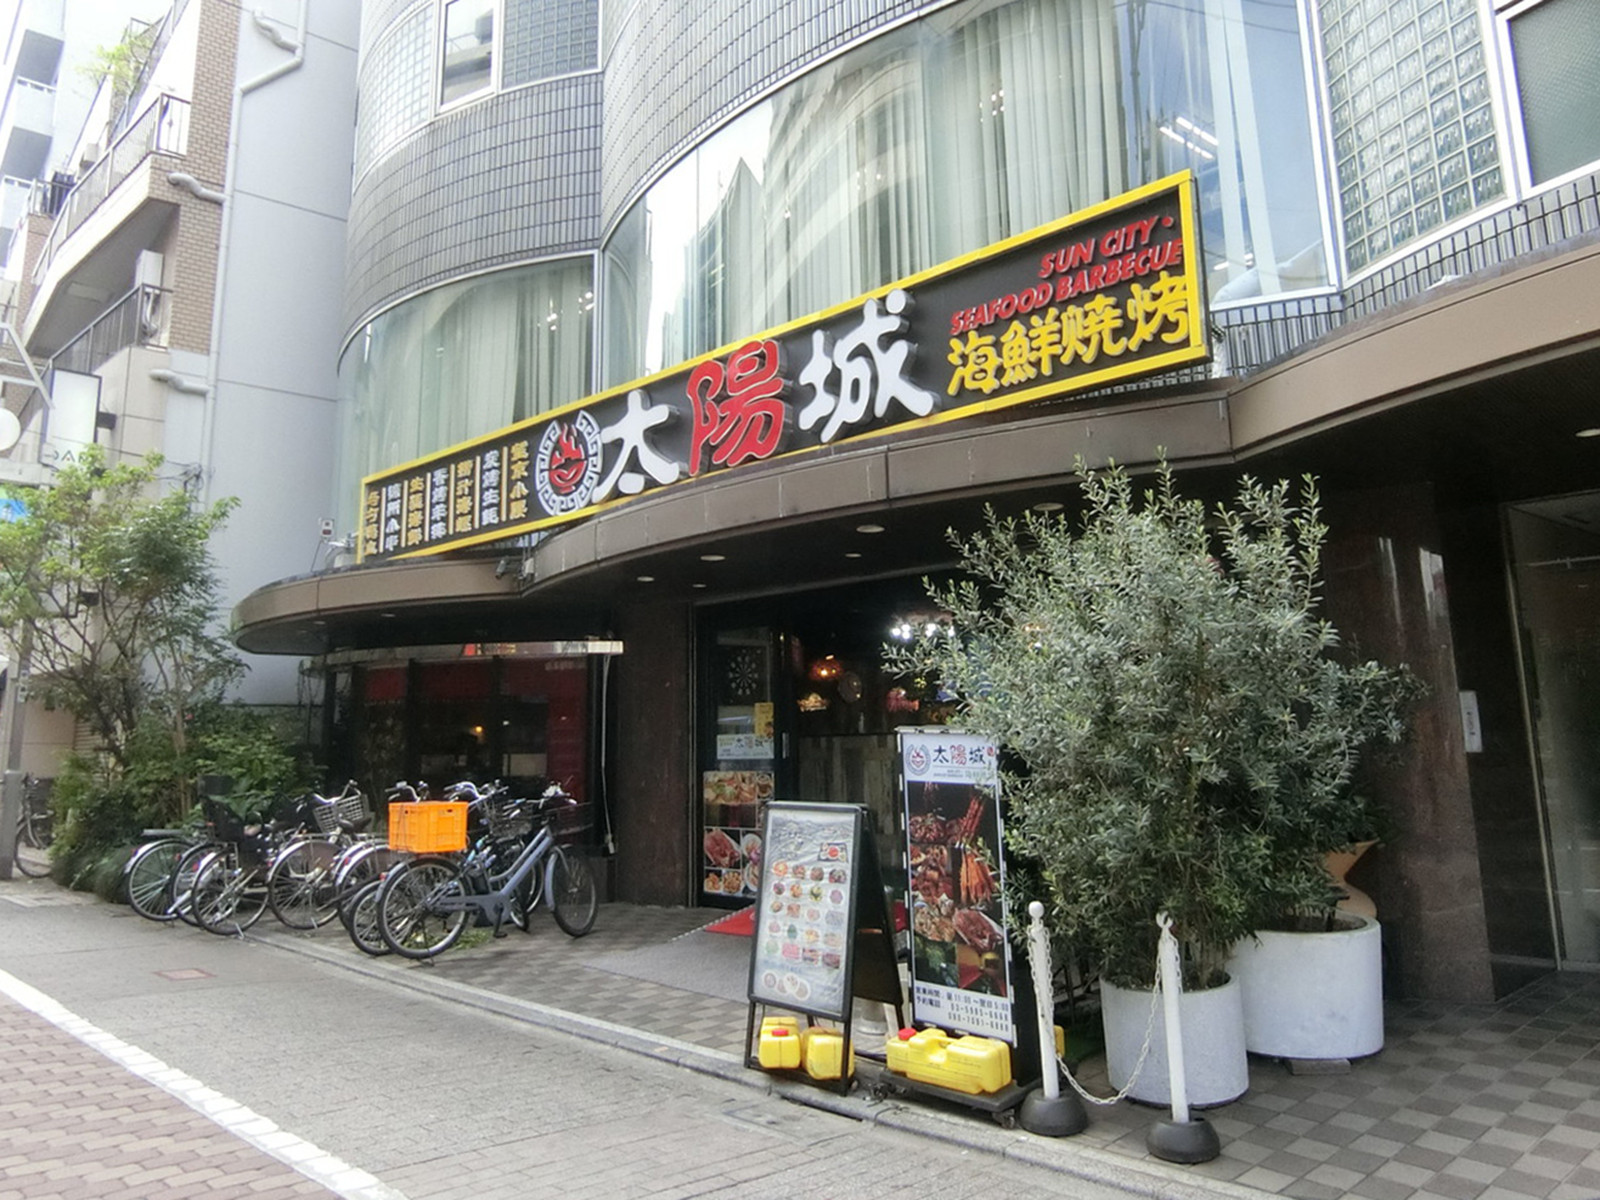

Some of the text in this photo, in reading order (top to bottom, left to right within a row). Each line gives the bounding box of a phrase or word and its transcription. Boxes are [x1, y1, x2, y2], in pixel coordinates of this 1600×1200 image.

[949, 237, 1184, 336] SEAFOOD BARBECUE
[1038, 237, 1096, 279] SUN
[592, 288, 935, 504] 太陽城
[932, 743, 987, 766] 太陽城
